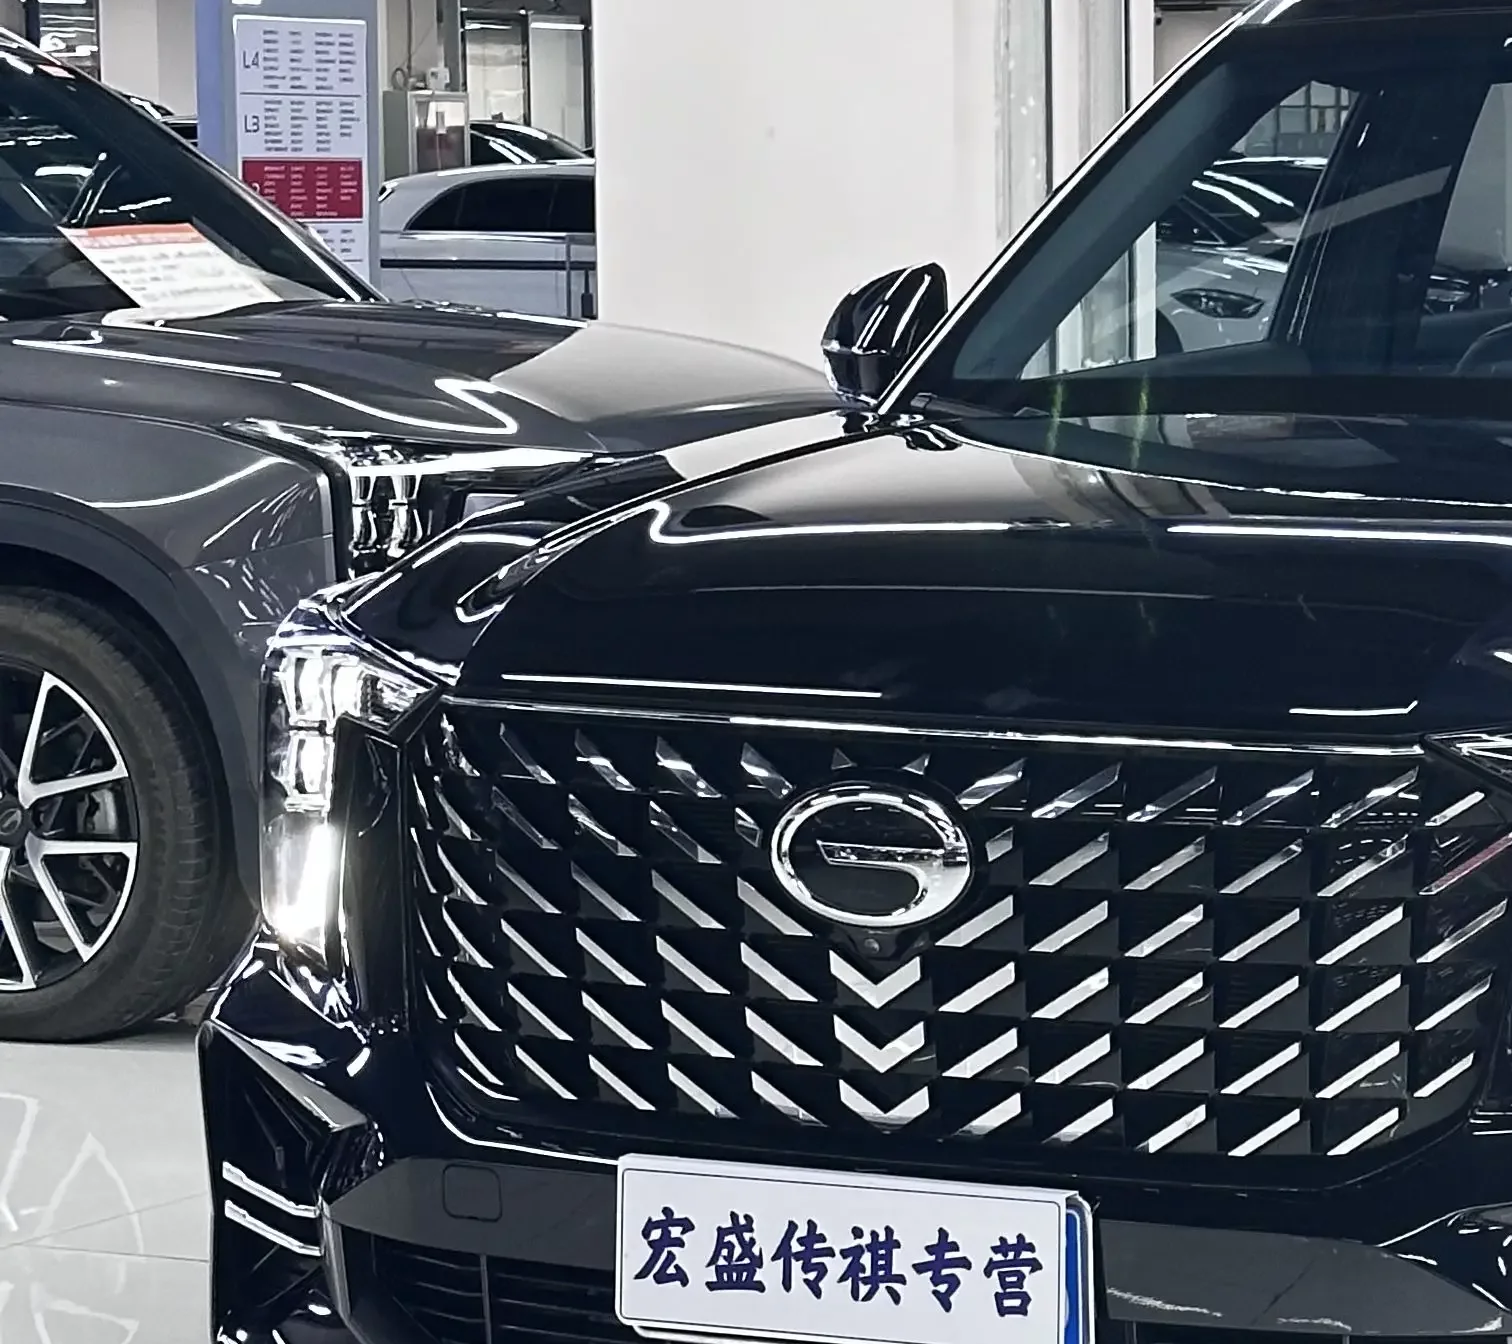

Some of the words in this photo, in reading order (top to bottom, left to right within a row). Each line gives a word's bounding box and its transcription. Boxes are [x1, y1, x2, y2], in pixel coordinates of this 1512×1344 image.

[244, 115, 260, 133] L3
[633, 1206, 1043, 1317] 宏盛传祺专营
